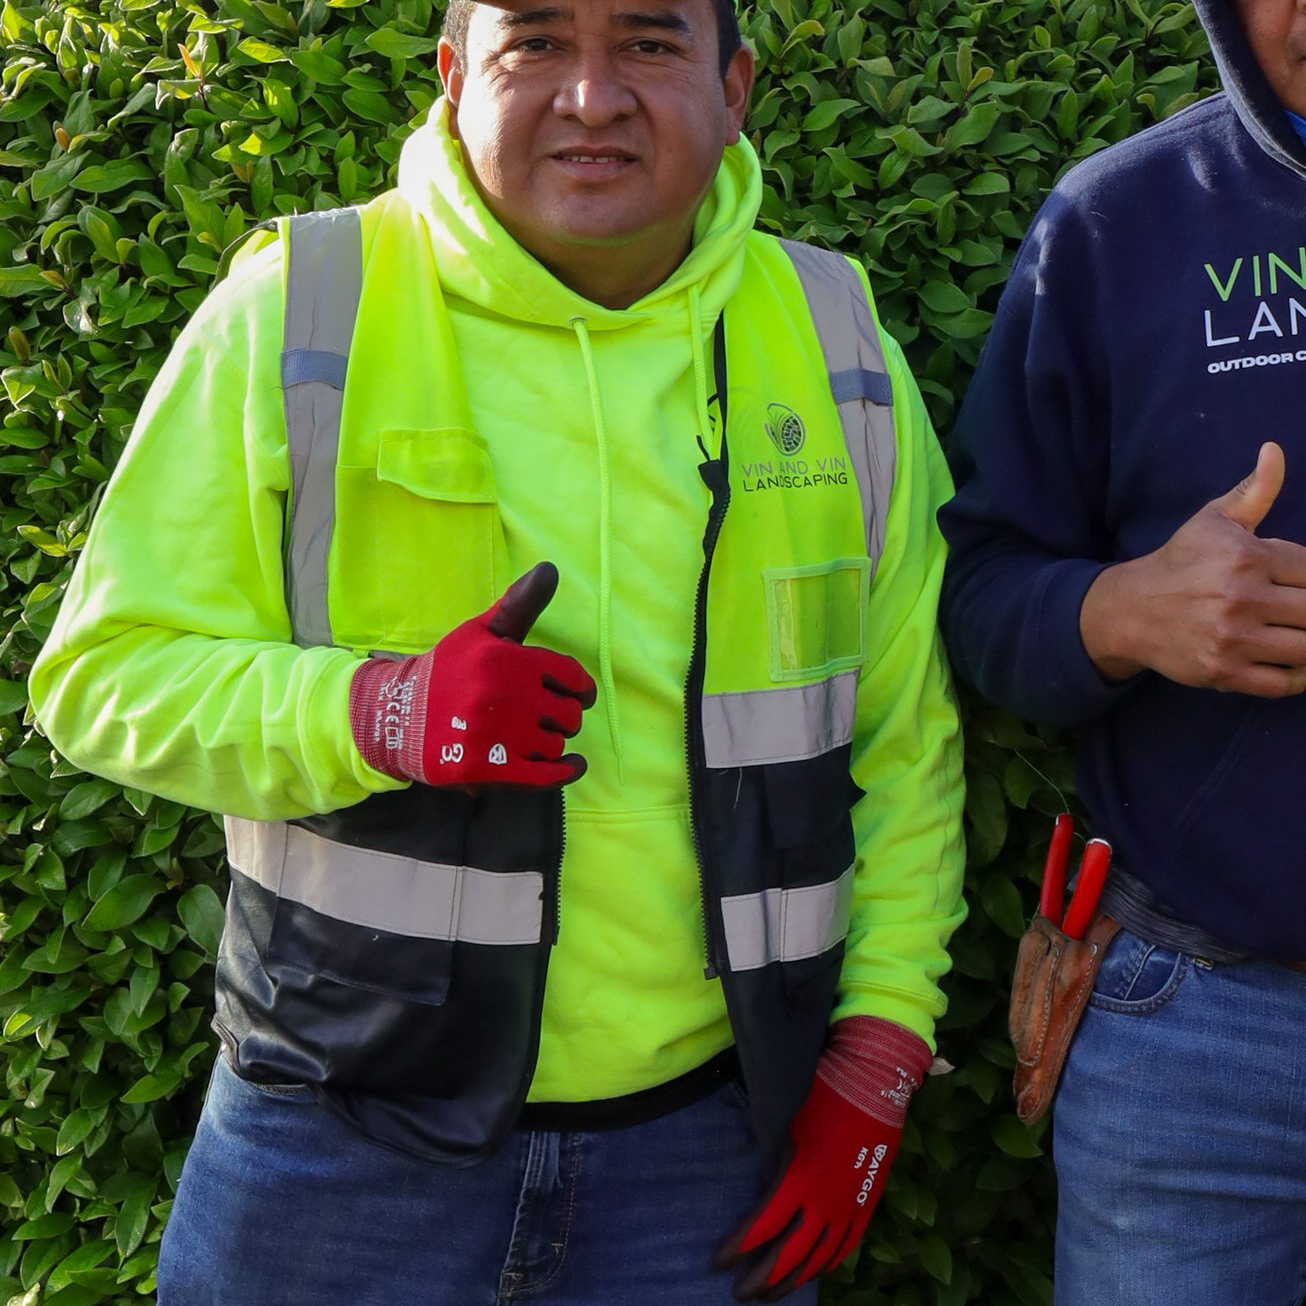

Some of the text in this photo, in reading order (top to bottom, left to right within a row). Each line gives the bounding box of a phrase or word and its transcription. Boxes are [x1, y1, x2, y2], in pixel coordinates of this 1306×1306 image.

[1207, 352, 1294, 374] OUTDOOR
[741, 457, 847, 478] VIN AND VIN
[743, 472, 848, 492] LANDSCAPING
